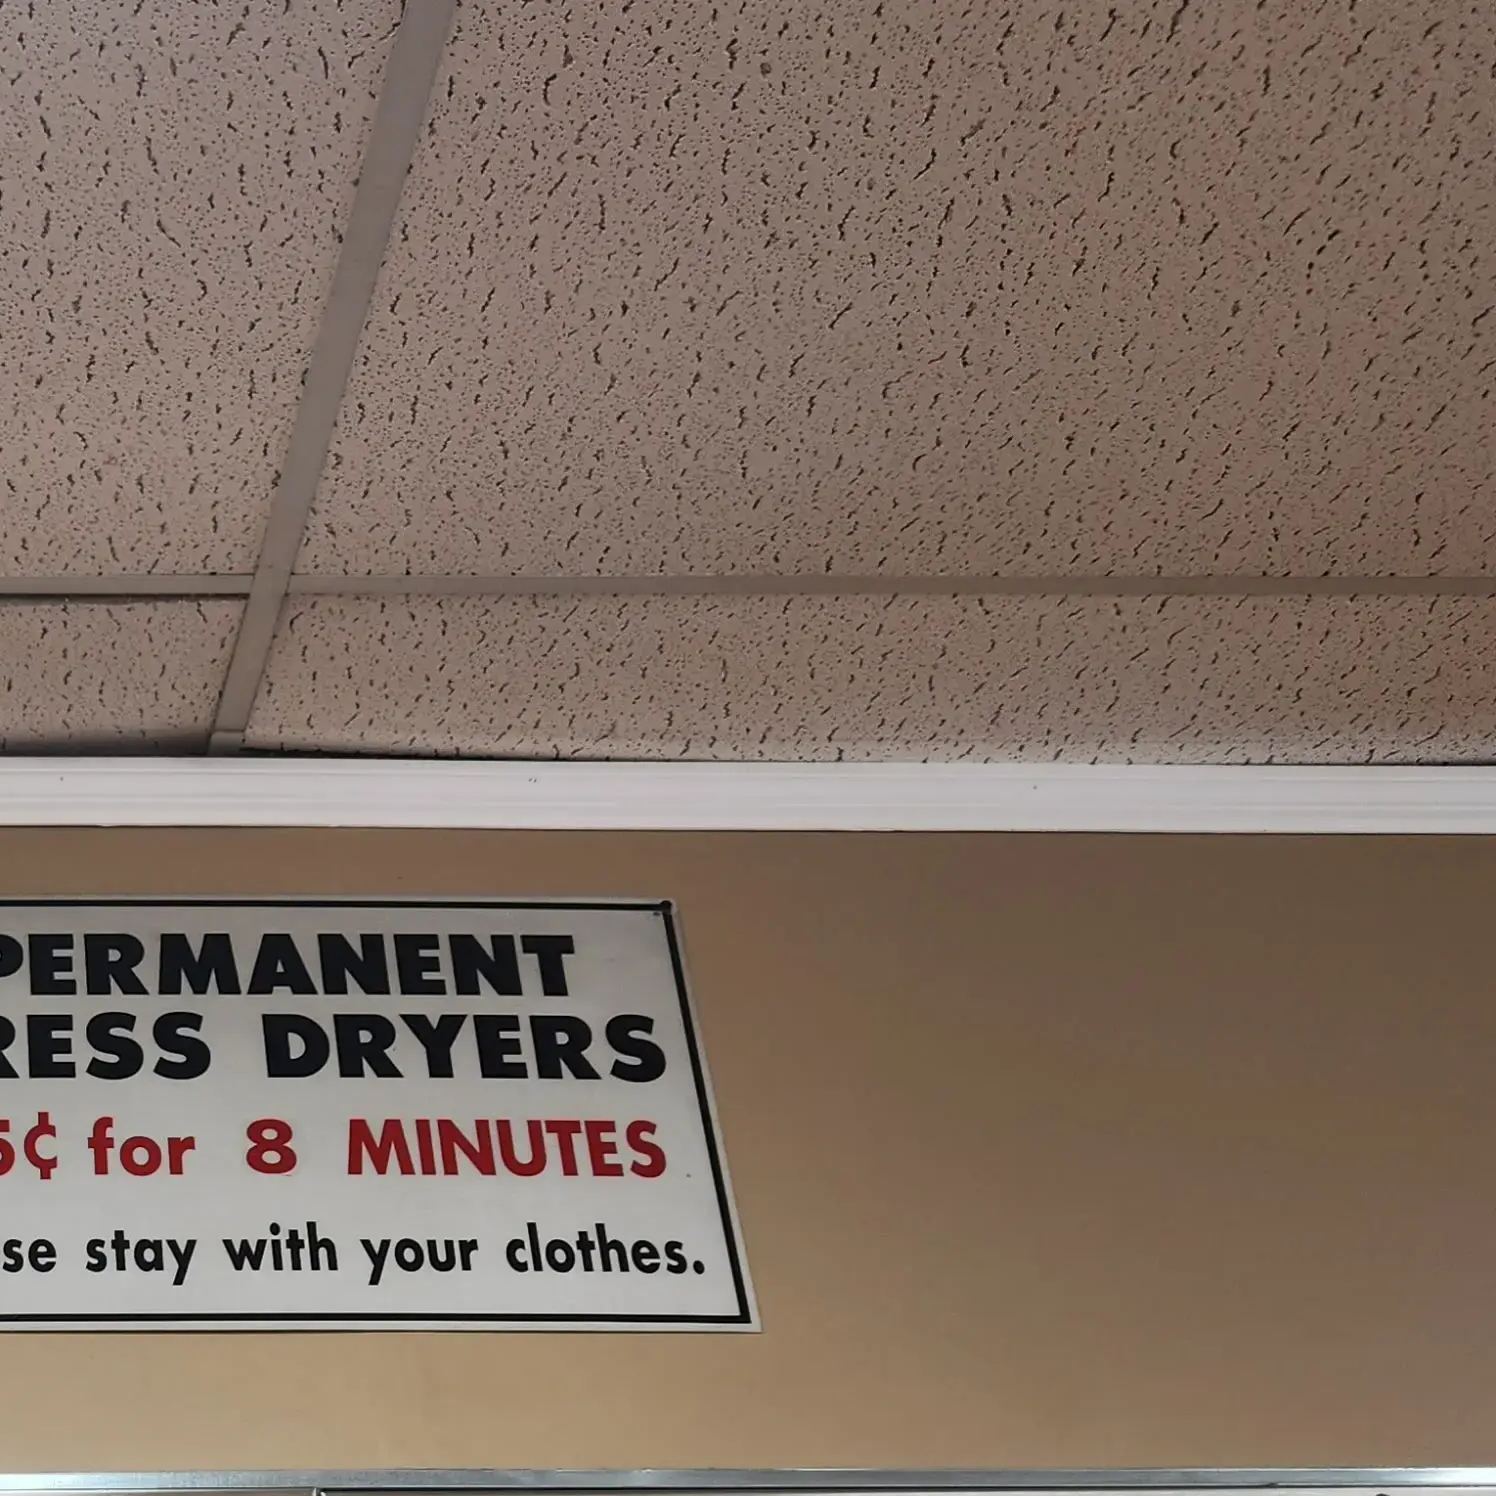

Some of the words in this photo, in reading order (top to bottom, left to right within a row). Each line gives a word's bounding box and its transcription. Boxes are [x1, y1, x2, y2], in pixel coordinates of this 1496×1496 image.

[262, 1012, 668, 1084] DRYERS
[87, 1112, 196, 1177] for
[244, 1117, 298, 1178] 8
[346, 1118, 668, 1179] MINUTES
[84, 1228, 198, 1287] stay
[222, 1221, 339, 1273] with
[361, 1233, 479, 1287] your
[504, 1222, 706, 1276] clothes.
